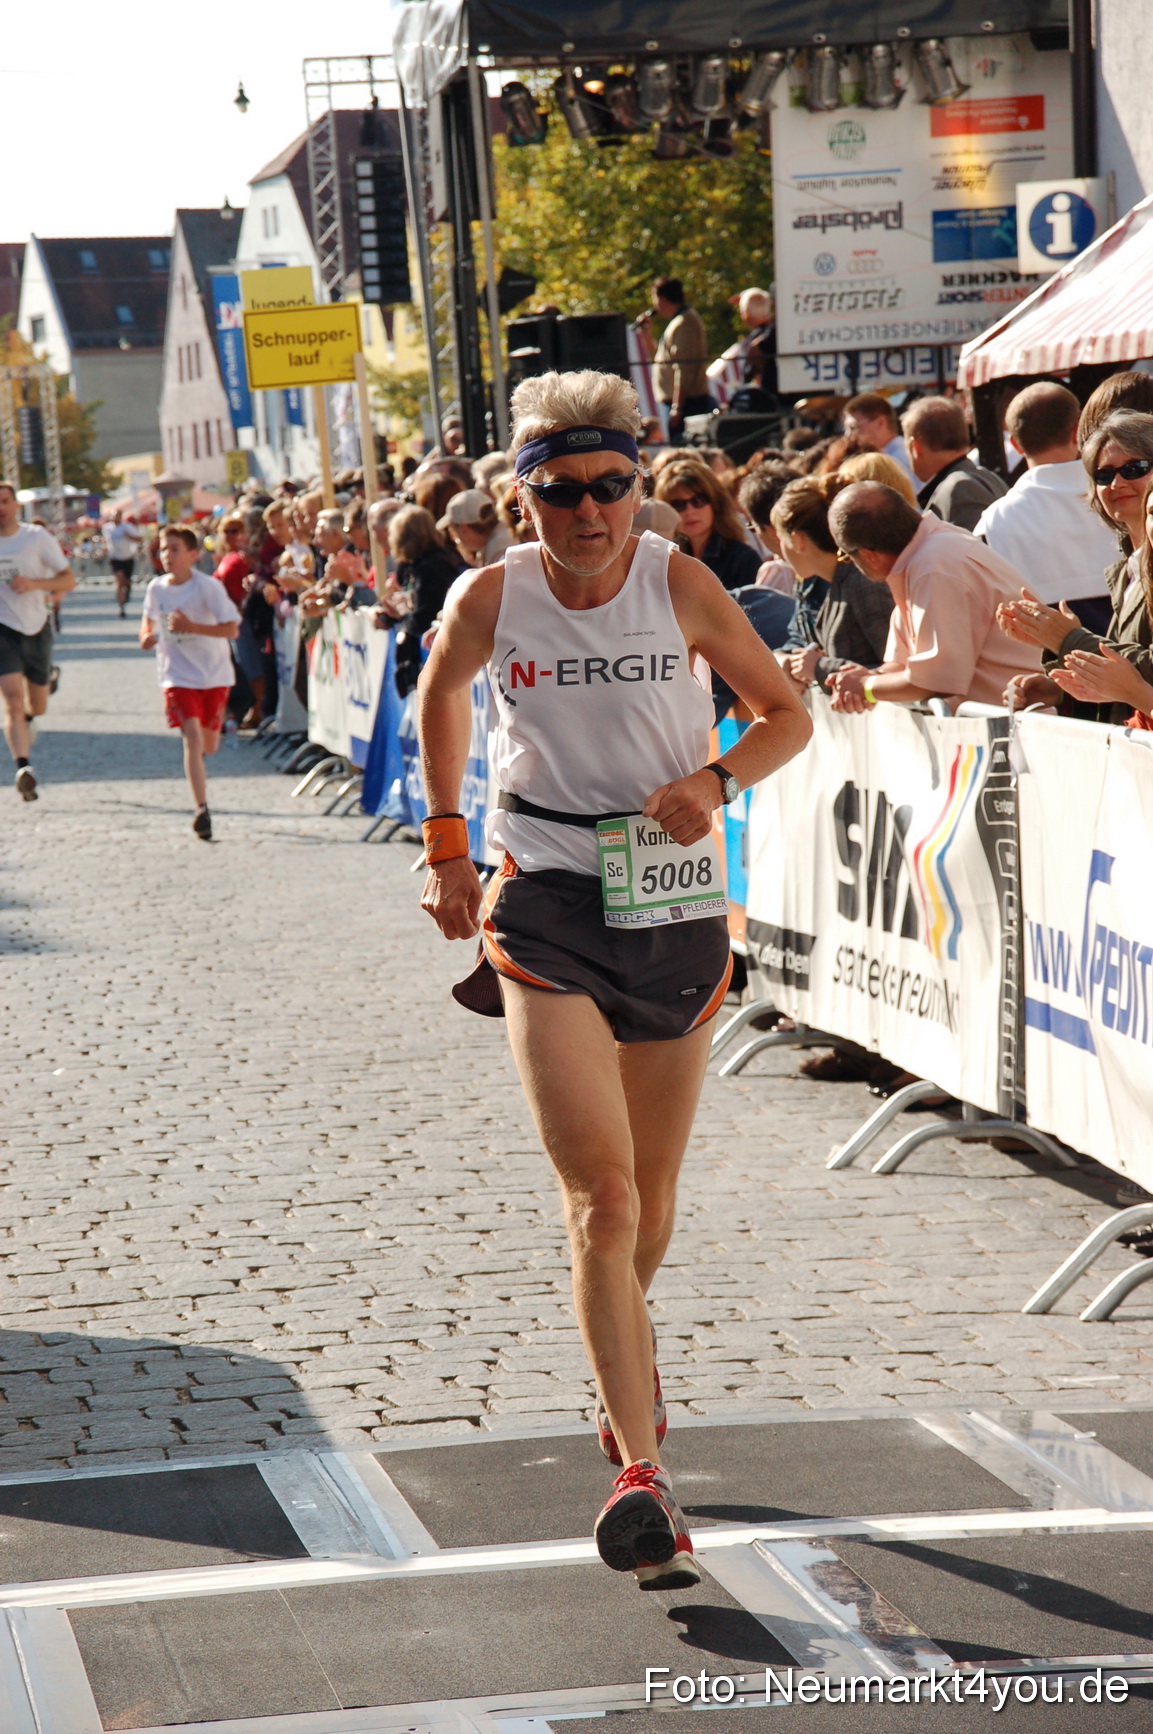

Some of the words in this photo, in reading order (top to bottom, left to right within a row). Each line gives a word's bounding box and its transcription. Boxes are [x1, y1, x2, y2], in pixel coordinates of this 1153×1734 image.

[252, 328, 353, 349] Schnupper-
[288, 350, 320, 367] lauf
[510, 654, 681, 690] N-ERGIE
[606, 862, 624, 878] Sc
[641, 856, 713, 895] 5008
[682, 898, 728, 914] PFLEIDERER
